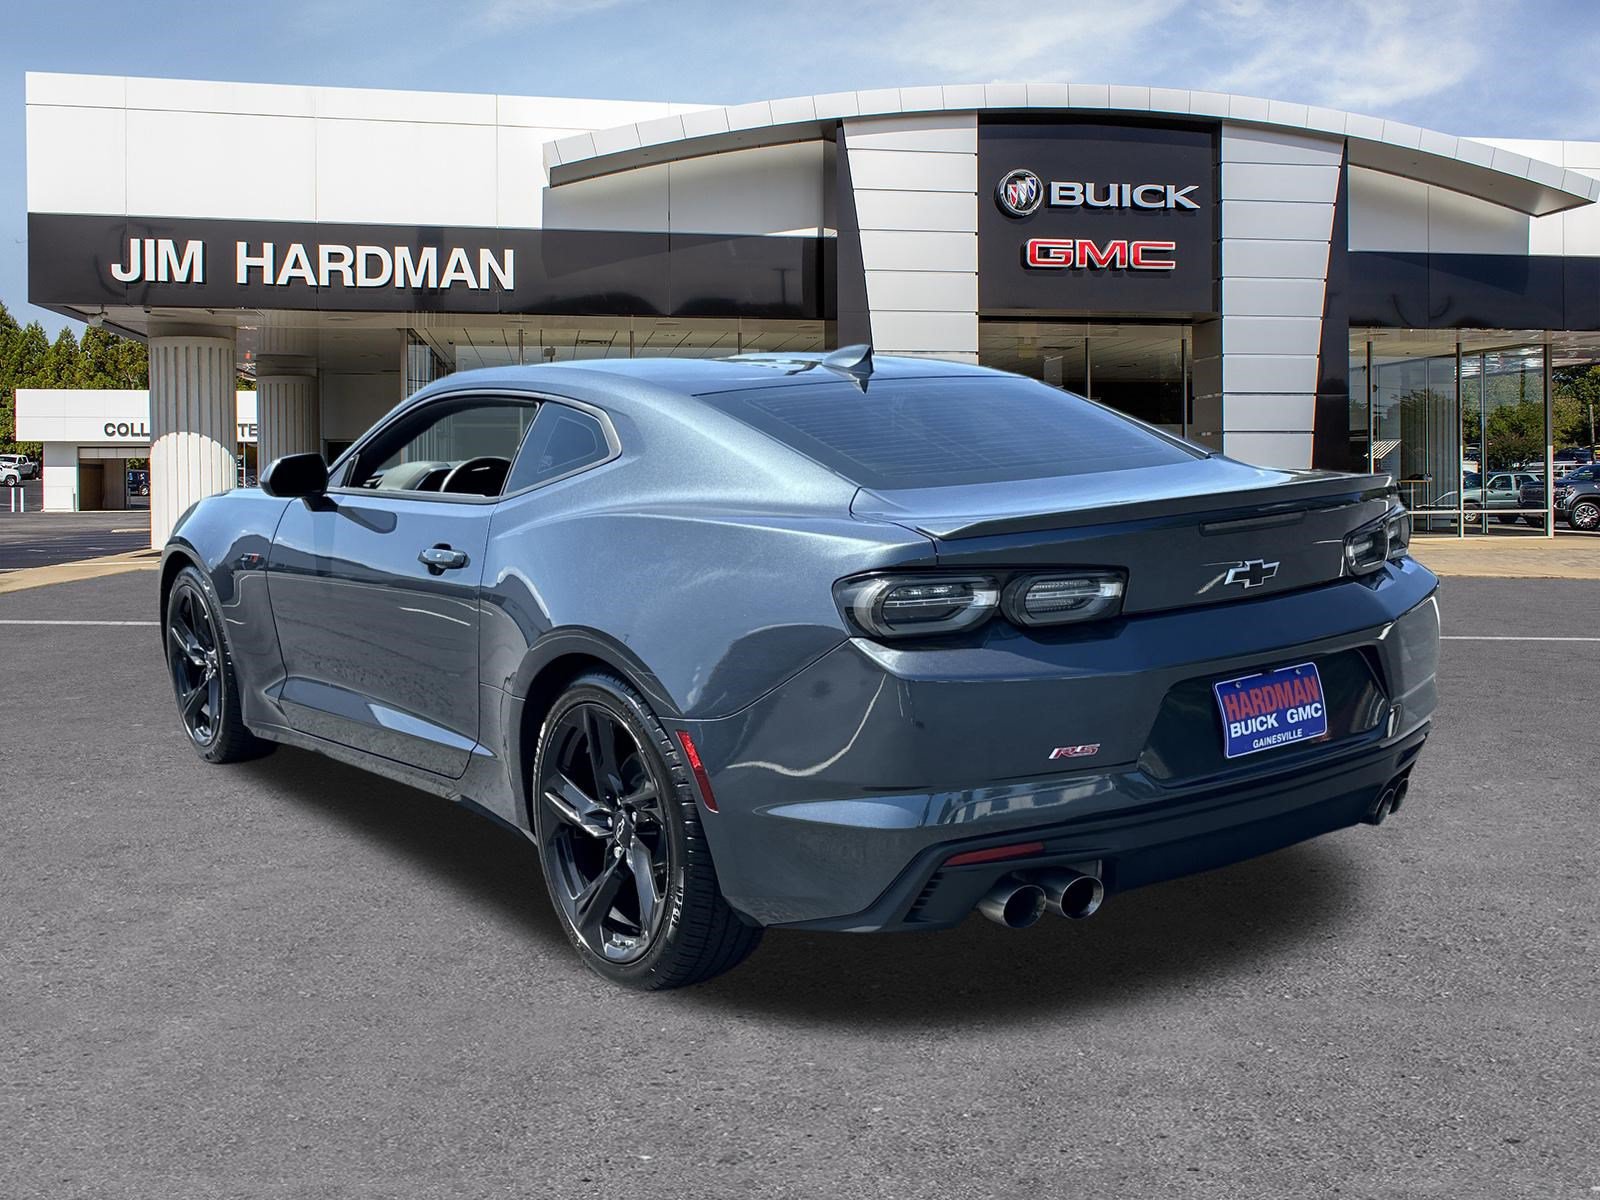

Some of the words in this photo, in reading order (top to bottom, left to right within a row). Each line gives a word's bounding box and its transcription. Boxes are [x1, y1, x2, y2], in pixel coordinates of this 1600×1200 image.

[1050, 181, 1200, 210] BUICK
[110, 238, 205, 284] JIM
[236, 241, 515, 291] HARDMAN
[1025, 238, 1176, 271] GMC
[104, 422, 150, 437] COLL
[1223, 675, 1321, 722] HARDMAN
[1230, 712, 1279, 738] BUICK
[1286, 702, 1322, 724] GMC
[1048, 743, 1101, 760] RS
[1252, 728, 1303, 749] GAINESVILLE
